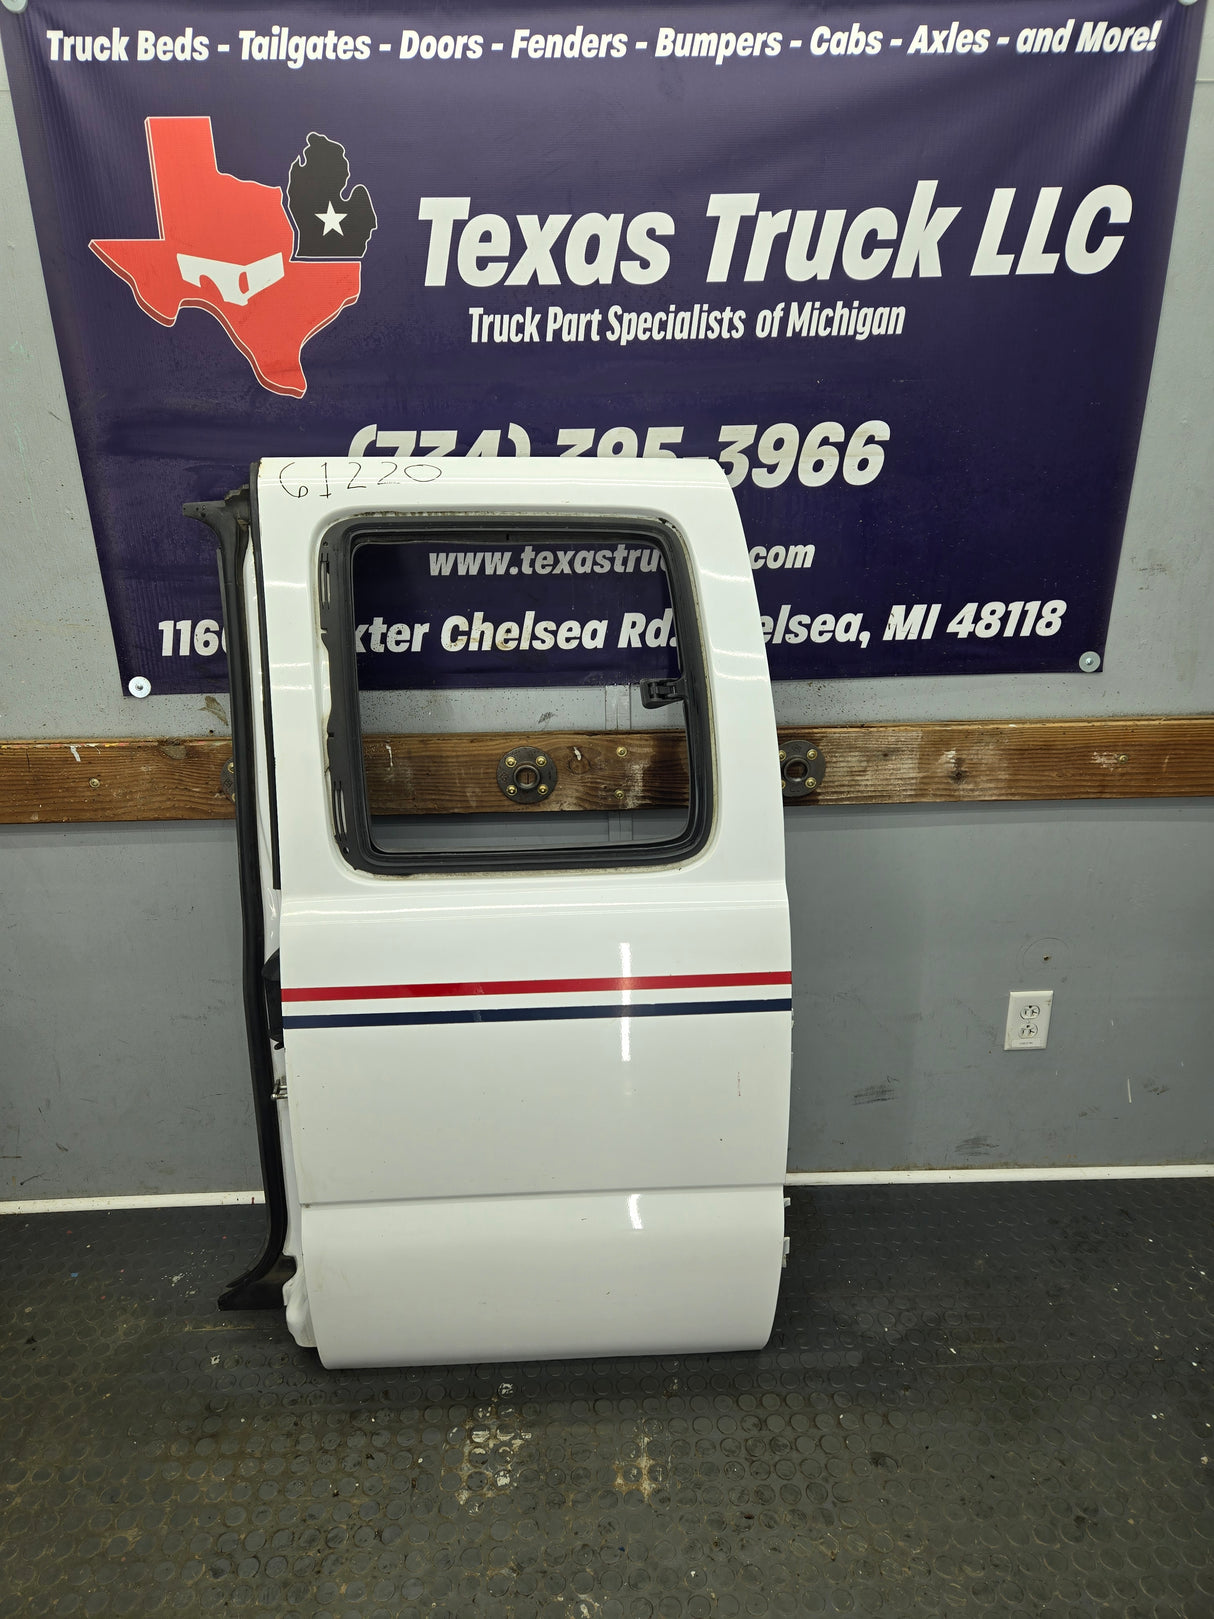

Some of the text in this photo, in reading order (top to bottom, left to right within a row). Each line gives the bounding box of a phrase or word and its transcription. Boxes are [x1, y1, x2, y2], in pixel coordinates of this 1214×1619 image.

[47, 27, 129, 62] Truck
[137, 27, 210, 62] Beds
[239, 25, 371, 70] Tailgates
[399, 30, 484, 60] Doors
[511, 26, 629, 59] Fenders
[655, 27, 783, 65] Bumpers
[810, 22, 884, 56] Cabs
[907, 21, 991, 55] Axles
[1016, 19, 1072, 54] and
[1075, 19, 1163, 53] More!
[418, 179, 1133, 288] Texas Truck LLC
[469, 300, 906, 346] Truck Part Specialists of Michigan
[279, 461, 443, 499] 61220
[158, 618, 228, 657] 116
[441, 610, 609, 652] Chelsea
[617, 607, 678, 649] Rd.
[883, 603, 942, 641] MI
[946, 599, 1068, 639] 48118
